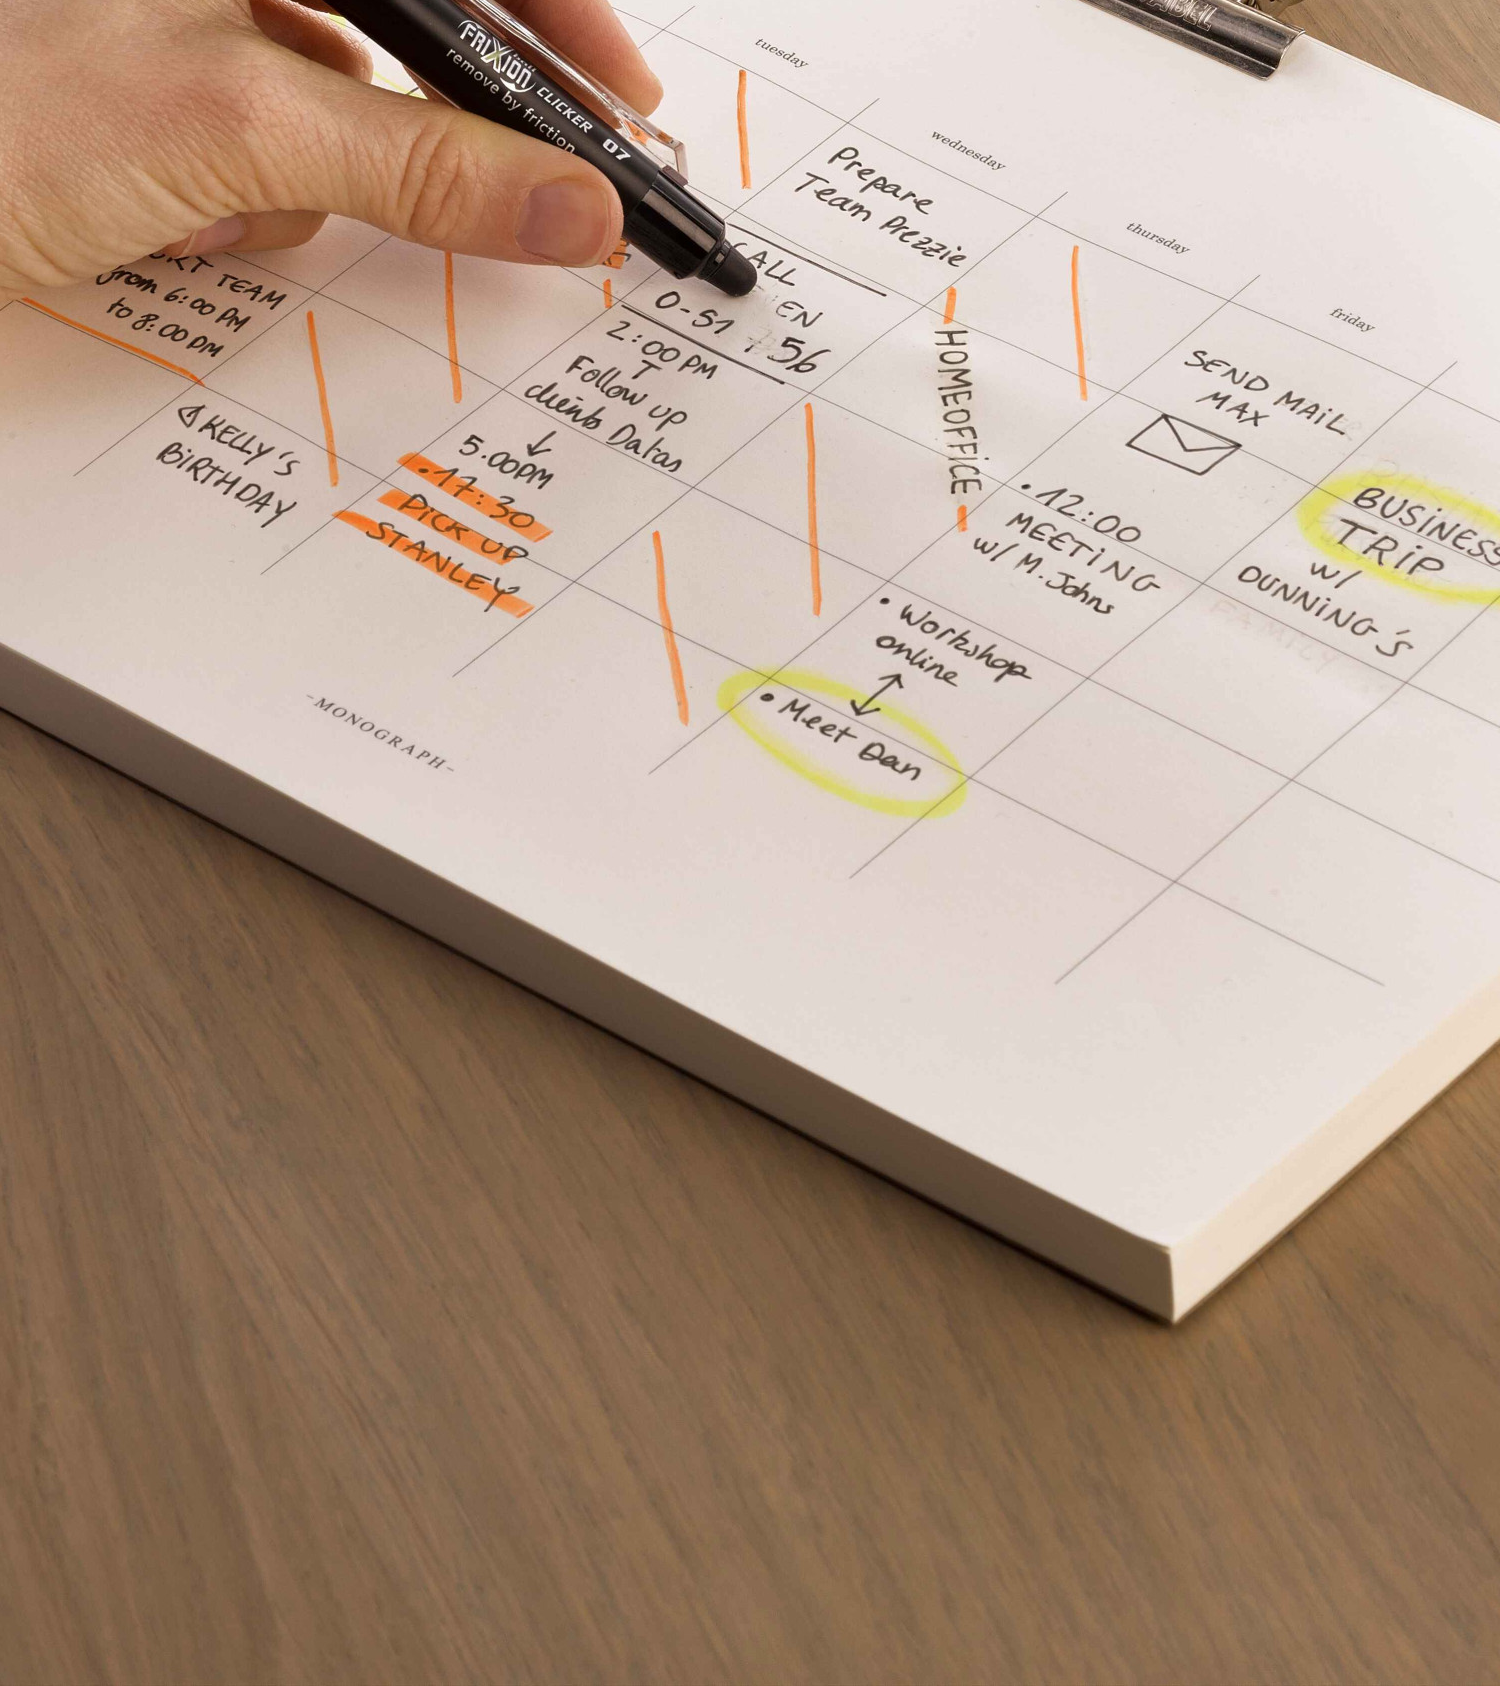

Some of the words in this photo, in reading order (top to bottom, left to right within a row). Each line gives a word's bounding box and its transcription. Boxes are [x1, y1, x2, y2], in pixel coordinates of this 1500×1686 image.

[754, 36, 810, 70] tuesday
[445, 46, 501, 96] remove
[500, 88, 523, 113] by
[522, 106, 577, 155] friction
[535, 86, 594, 135] CLICKER
[601, 137, 633, 163] 07
[930, 129, 1007, 173] wednesday
[793, 170, 872, 225] Team
[827, 144, 936, 216] Prepare
[1125, 221, 1192, 256] thursday
[163, 287, 217, 316] 6:00
[214, 306, 252, 333] PM
[216, 272, 288, 311] TEAM
[106, 296, 134, 319] to
[131, 313, 188, 343] 8:00
[186, 334, 225, 358] PM
[1328, 305, 1376, 335] friday
[605, 319, 682, 363] 2:00
[676, 354, 719, 381] PM
[1184, 349, 1270, 394] SEND
[565, 354, 650, 411] Follow
[1195, 390, 1271, 429] MAX
[605, 423, 683, 473] Datas
[1034, 486, 1143, 544] 12:00
[364, 520, 522, 614] STANLEY
[875, 634, 959, 688] online
[899, 603, 1033, 683] Workshop
[311, 696, 450, 772] MONOGRAPH
[778, 698, 858, 745] Meet
[858, 740, 921, 781] Dan
